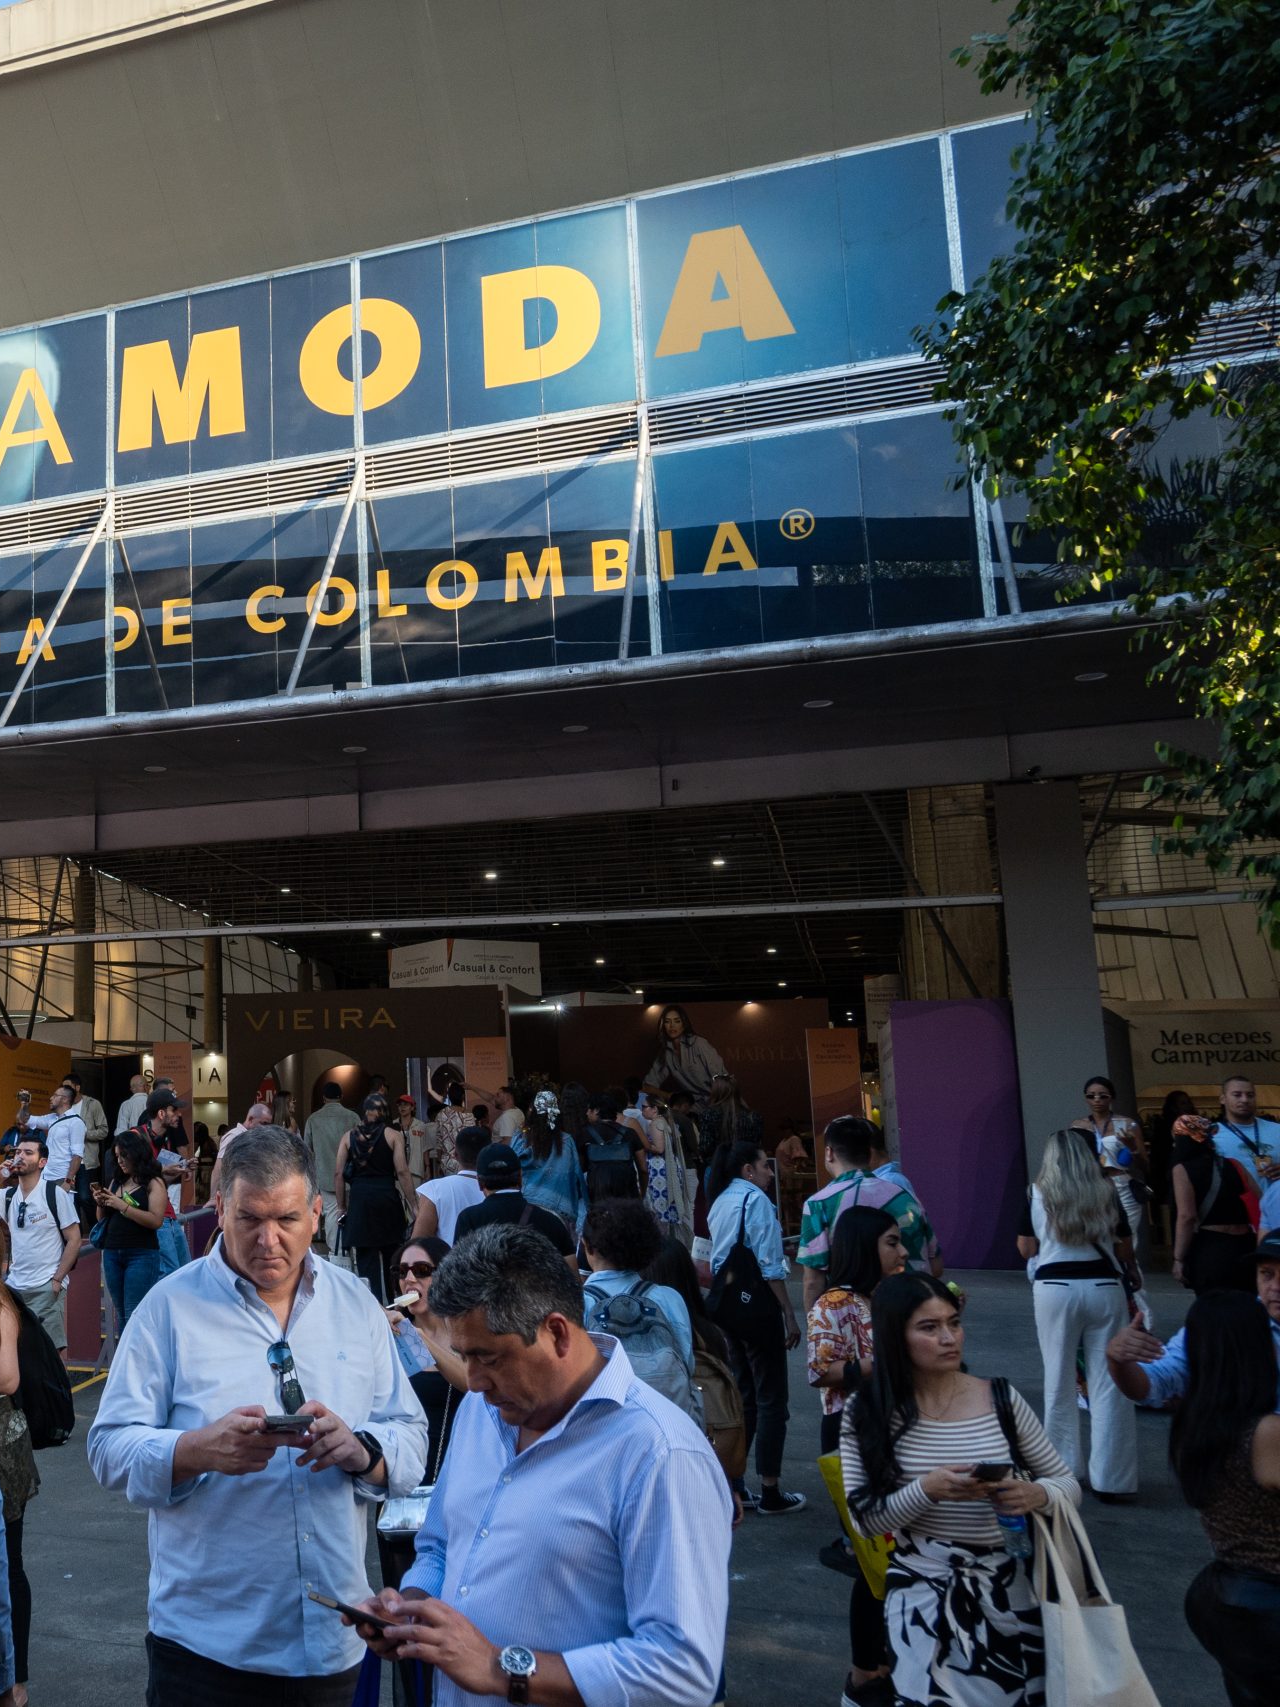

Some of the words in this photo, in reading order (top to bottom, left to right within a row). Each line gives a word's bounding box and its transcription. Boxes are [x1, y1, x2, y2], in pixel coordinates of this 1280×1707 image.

[113, 598, 193, 653] DE
[391, 968, 413, 980] Casual
[453, 962, 486, 973] Casual
[489, 964, 496, 973] &
[499, 964, 535, 975] Confort
[244, 1007, 397, 1032] VIEIRA
